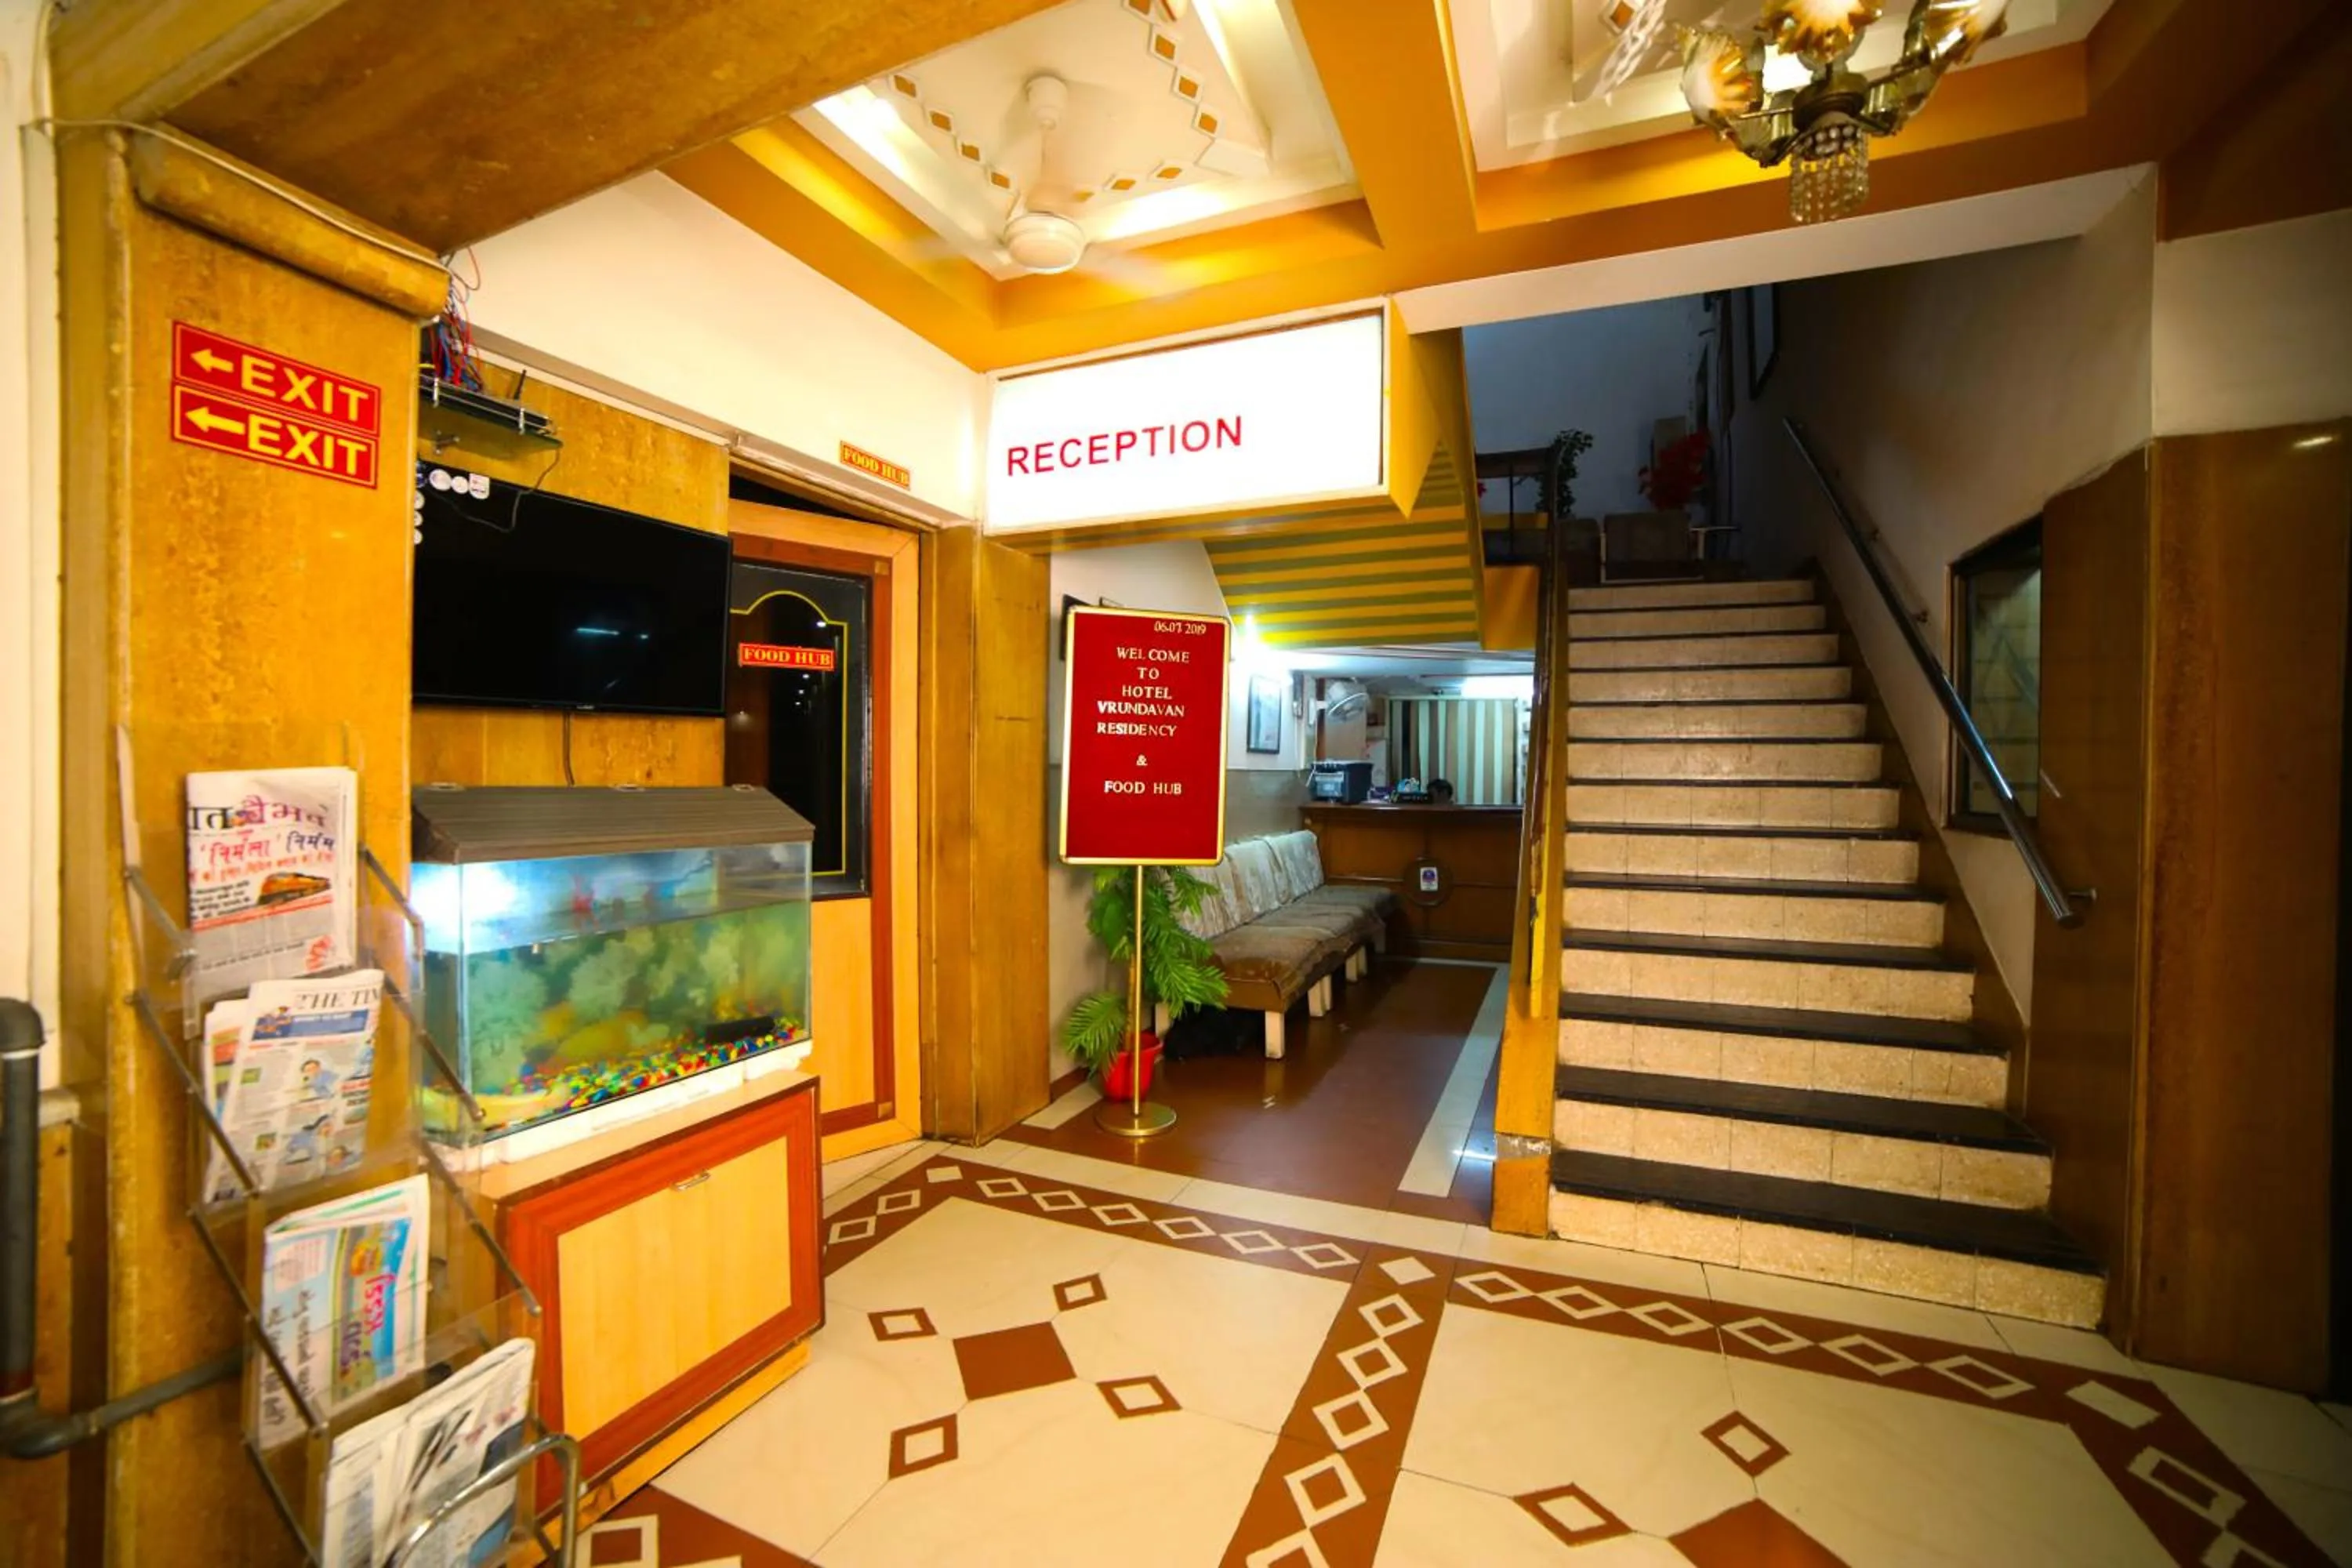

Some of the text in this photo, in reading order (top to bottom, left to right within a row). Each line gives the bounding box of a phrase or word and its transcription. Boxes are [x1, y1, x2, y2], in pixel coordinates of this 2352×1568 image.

[241, 354, 368, 422] EXIT
[248, 414, 368, 476] EXIT
[1007, 416, 1241, 477] RECEPTION
[844, 448, 879, 473] FOOD
[744, 648, 830, 666] FOOD HUB
[1116, 647, 1190, 663] WELCOME
[1137, 666, 1160, 680] TO
[1122, 685, 1172, 699] HOTEL
[1098, 700, 1185, 717] VRUNDAVAN
[1097, 721, 1177, 737] RESIDENCY
[1136, 754, 1148, 767] &
[1104, 780, 1182, 795] FOOD HUB
[296, 993, 346, 1010] THE
